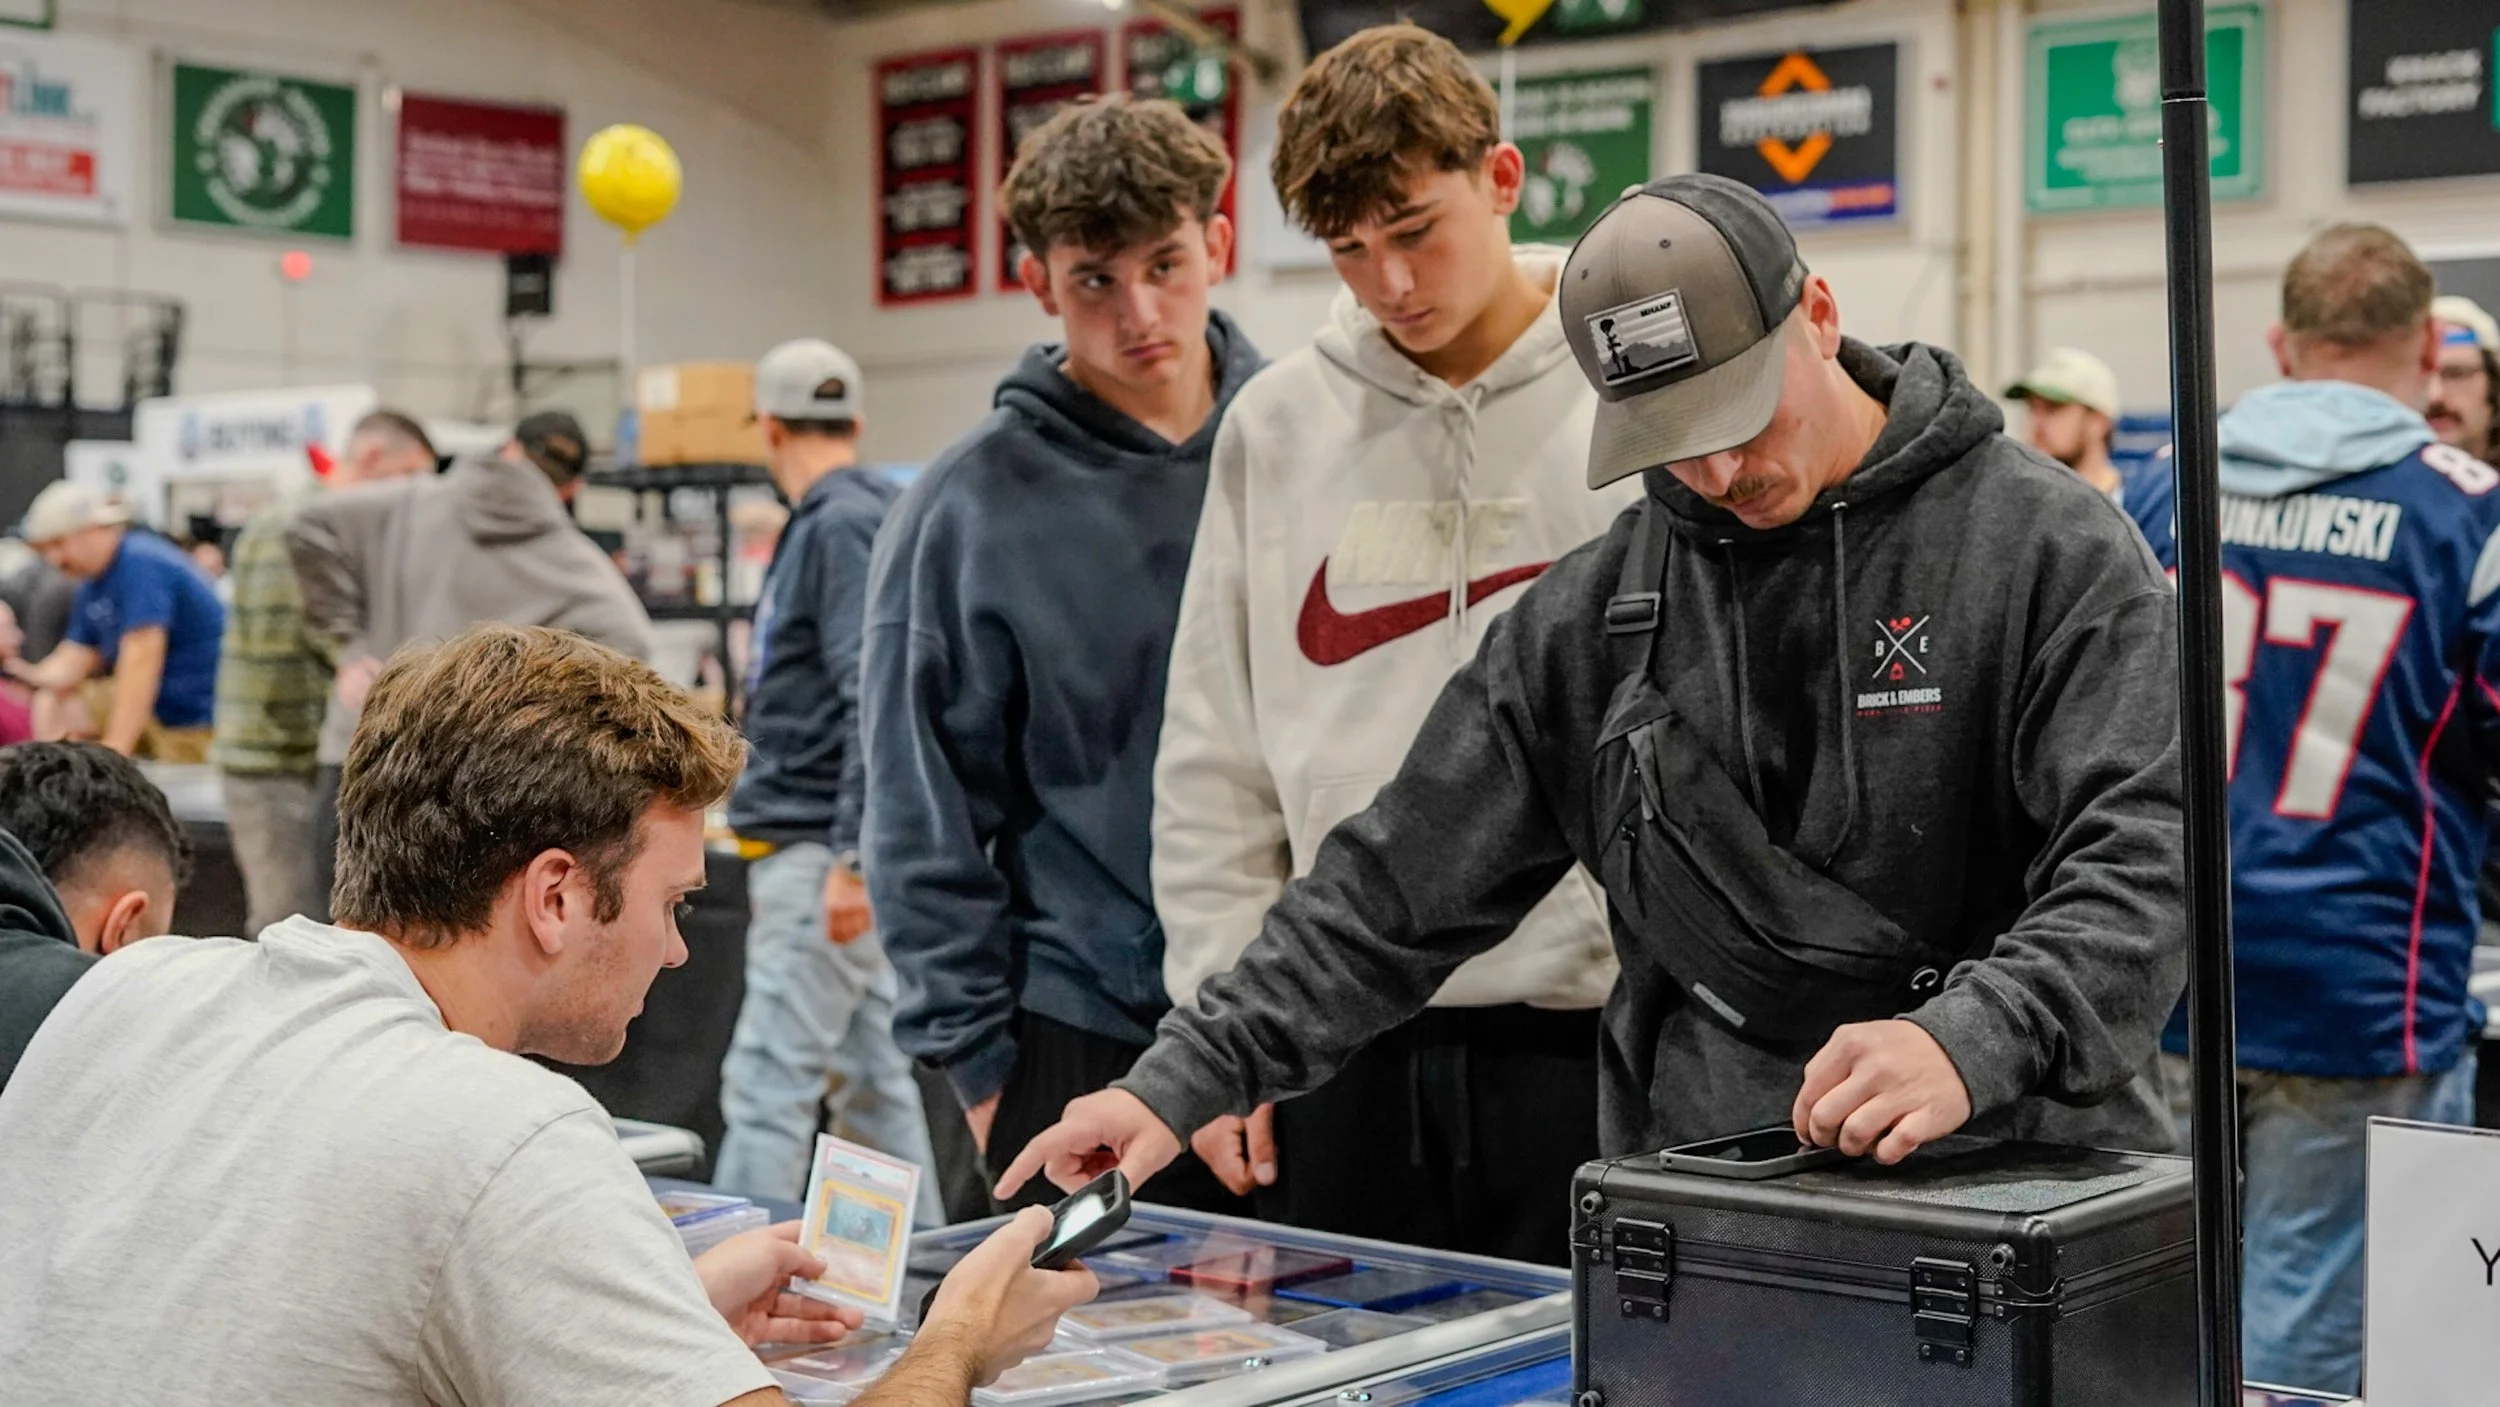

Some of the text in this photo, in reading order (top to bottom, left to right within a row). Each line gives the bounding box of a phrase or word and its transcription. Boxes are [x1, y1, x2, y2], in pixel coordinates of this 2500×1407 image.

[2170, 493, 2401, 561] ONKOWSKI
[1875, 636, 1929, 657] B E
[1857, 692, 1889, 708] BRICK
[1898, 687, 1941, 704] EMBERS
